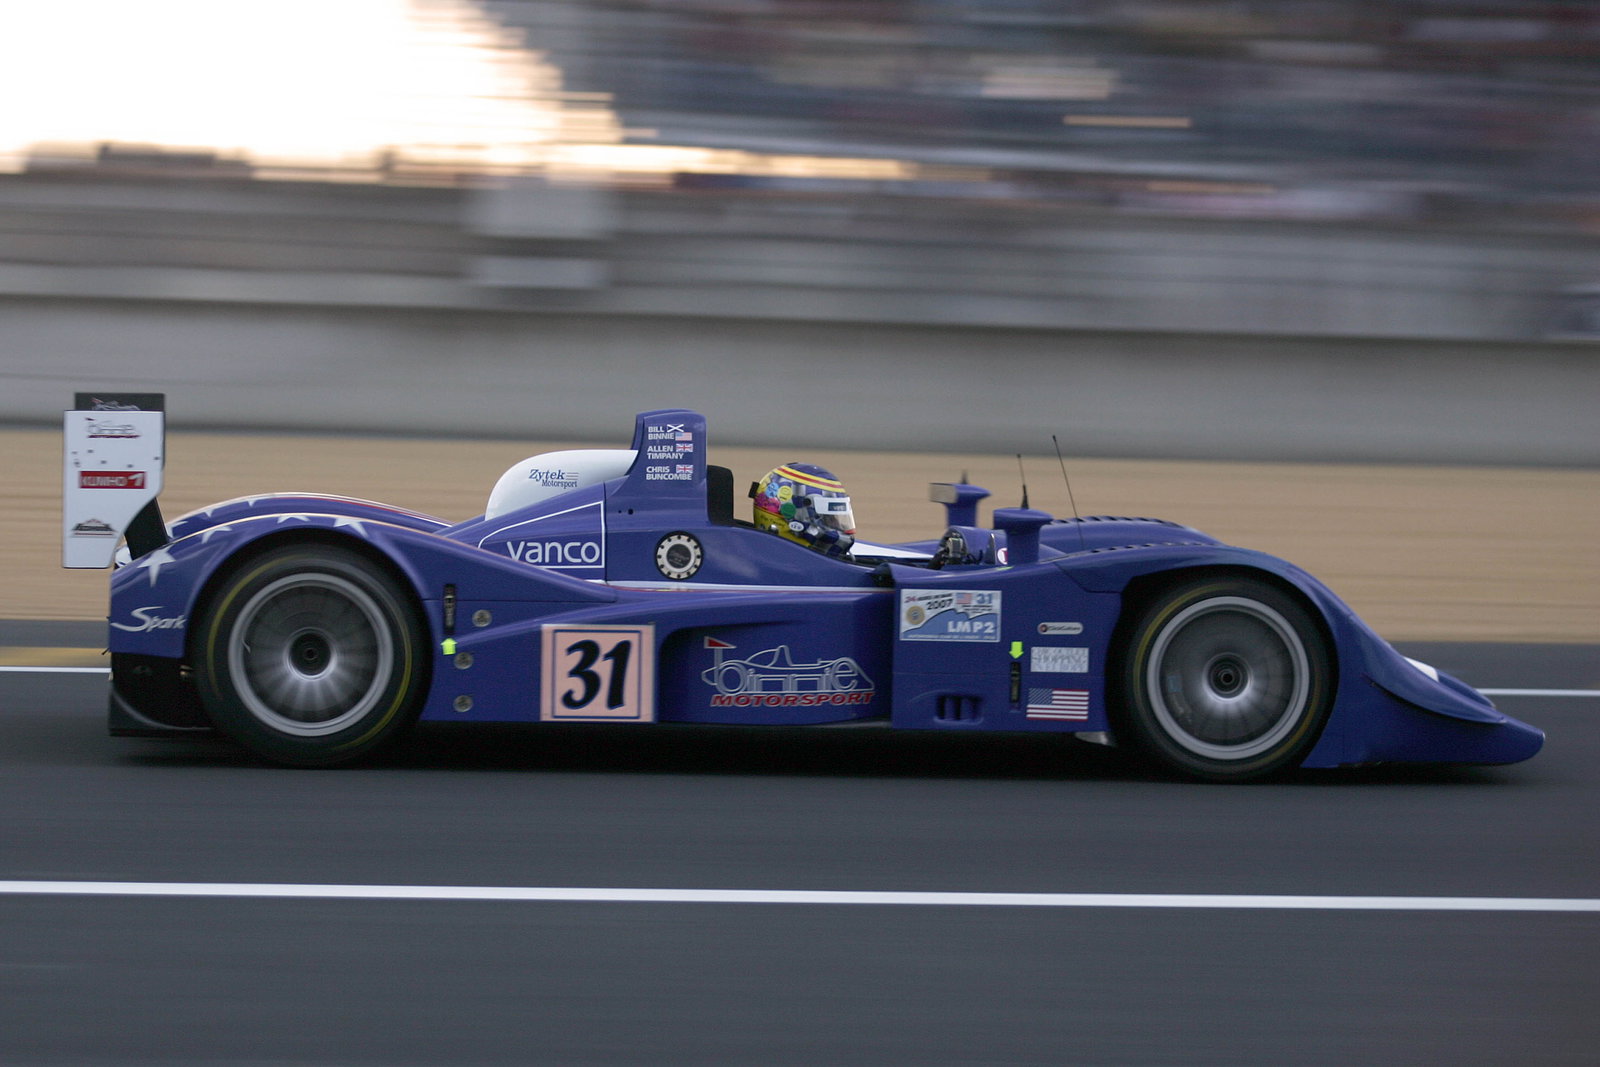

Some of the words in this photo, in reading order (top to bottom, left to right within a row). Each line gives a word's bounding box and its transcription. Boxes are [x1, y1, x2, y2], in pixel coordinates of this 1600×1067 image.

[529, 469, 565, 482] Zytek
[541, 479, 578, 489] Motorsport
[507, 541, 600, 563] vanco
[926, 599, 953, 610] 2007
[976, 593, 993, 604] 31
[561, 639, 632, 710] 31
[711, 692, 875, 707] MOTORSPORT
